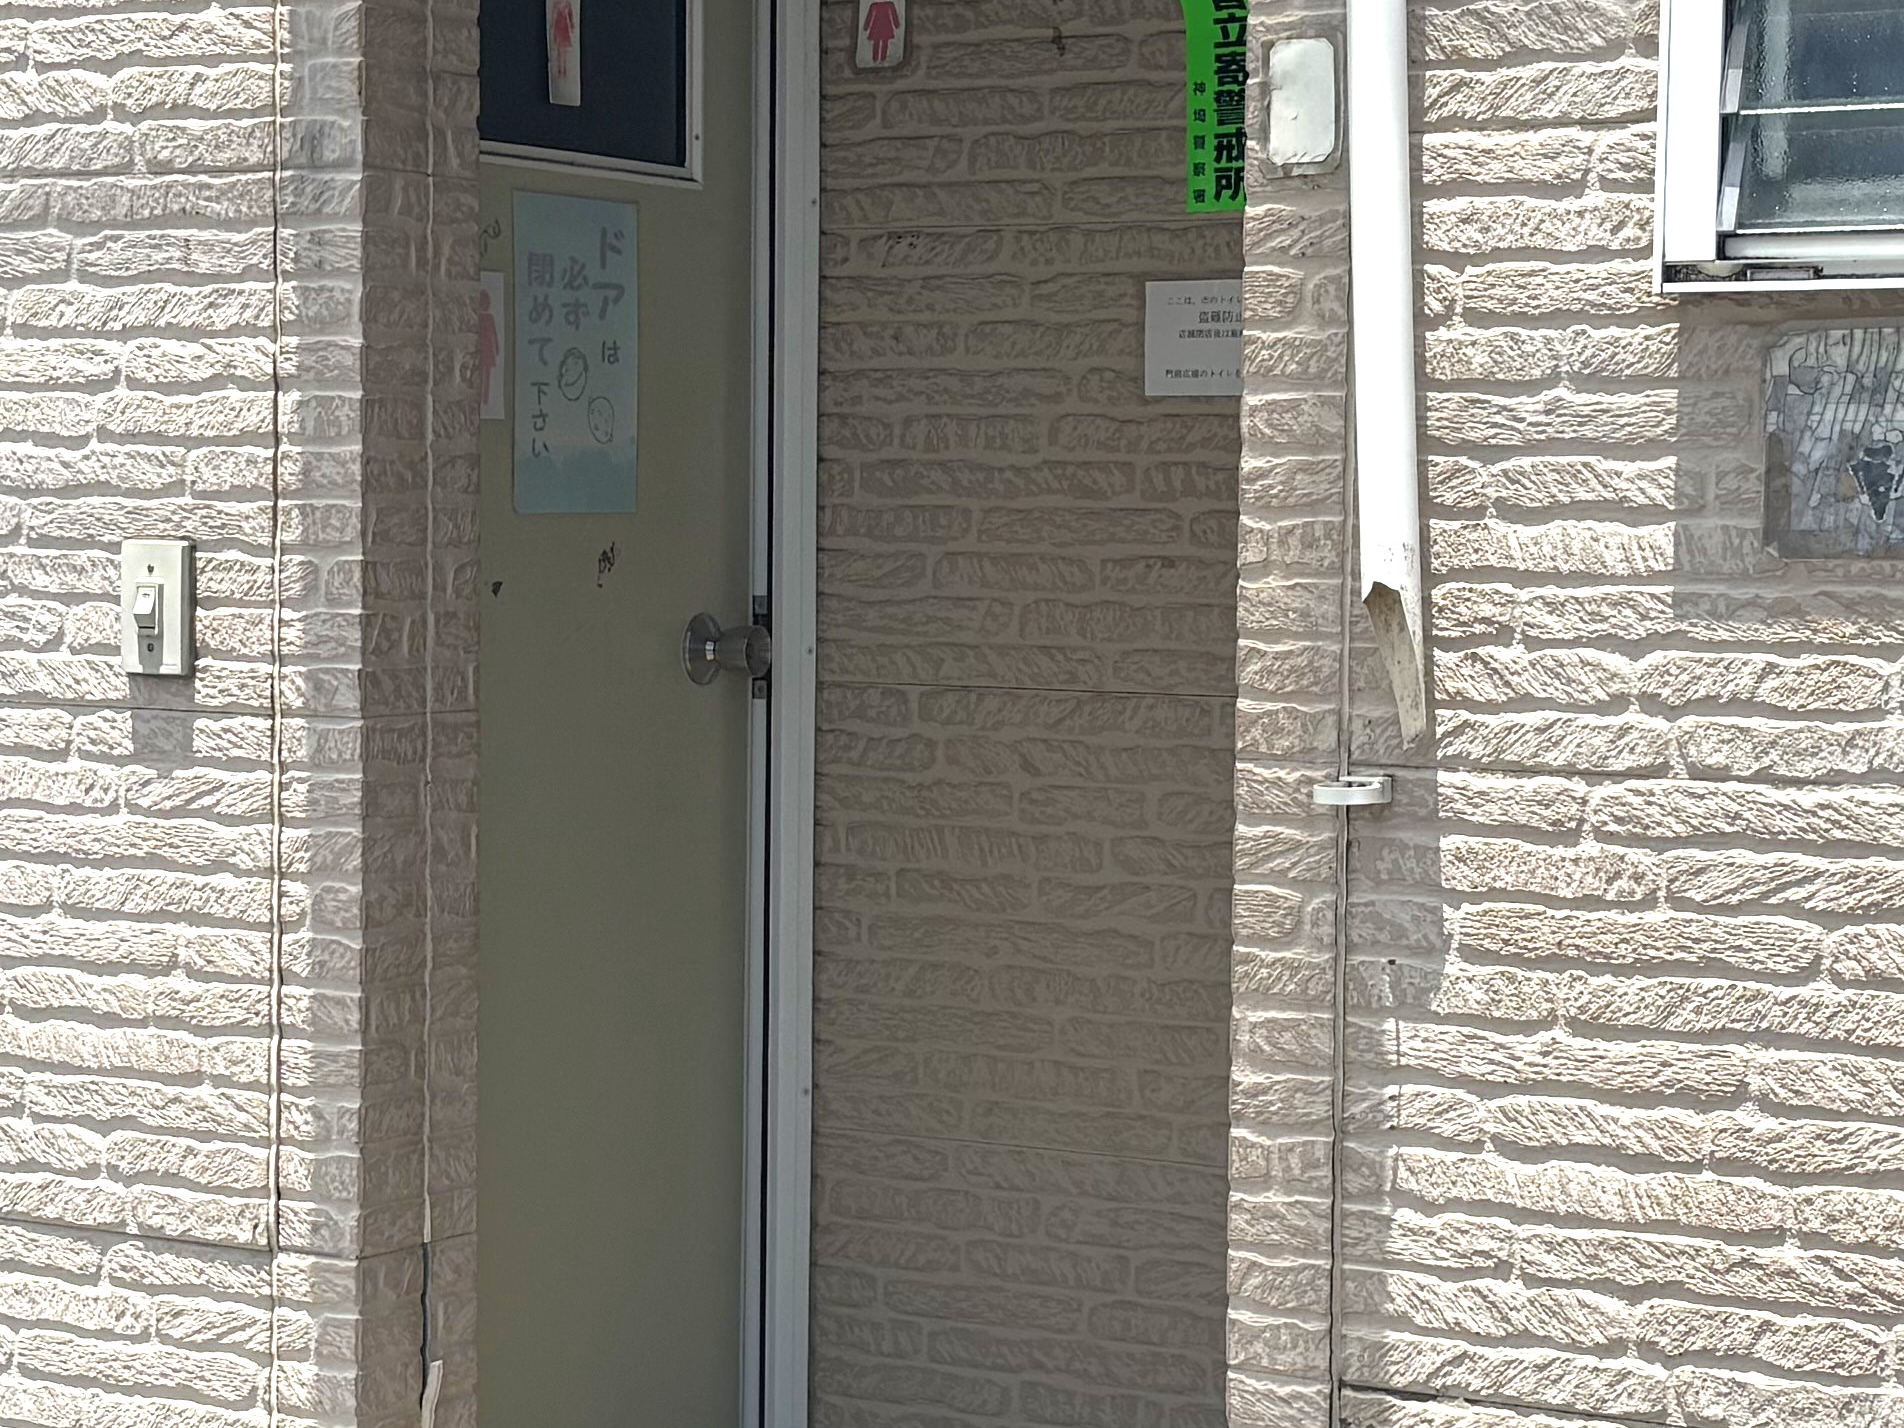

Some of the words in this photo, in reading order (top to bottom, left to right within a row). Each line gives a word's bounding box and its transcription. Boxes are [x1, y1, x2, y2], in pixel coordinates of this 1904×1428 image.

[527, 251, 555, 459] 閉めて下さい
[560, 256, 590, 331] 必ず
[592, 226, 626, 365] ドアは
